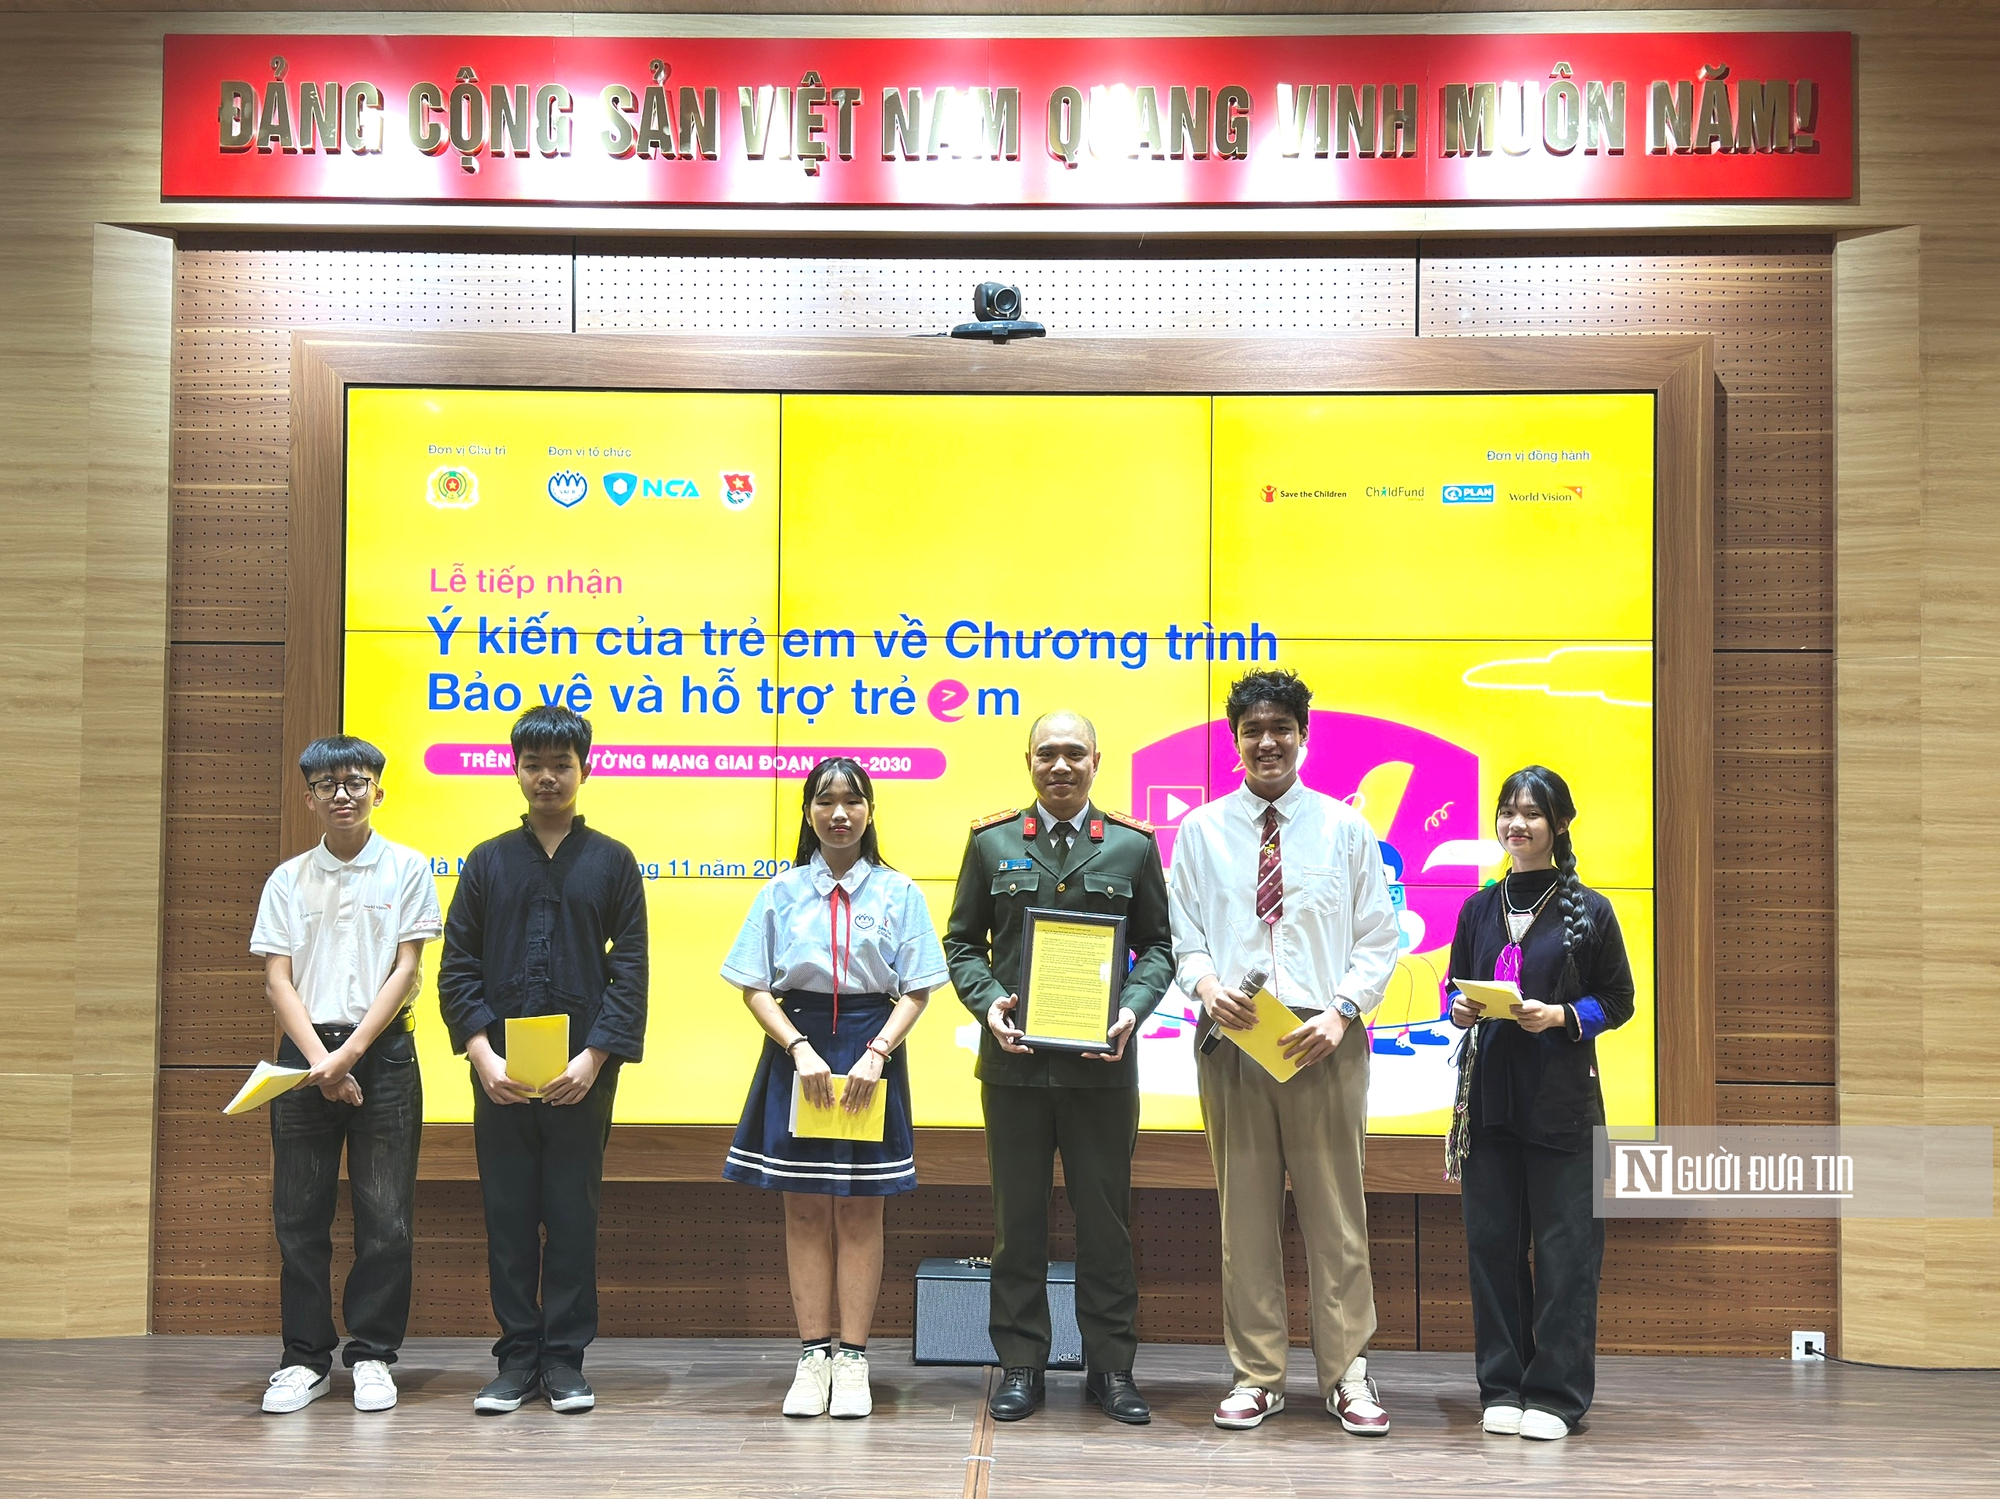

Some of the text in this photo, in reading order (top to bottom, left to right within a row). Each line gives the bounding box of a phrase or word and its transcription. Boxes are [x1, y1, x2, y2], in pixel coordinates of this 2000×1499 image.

[219, 56, 1819, 175] ĐẢNG CỘNG SẢN VIỆT NAM QUANG VINH MUÔN NĂM!
[429, 444, 452, 455] Đơn
[549, 446, 572, 456] Đơn
[1487, 450, 1511, 461] Đơn
[643, 479, 700, 497] NCA
[1280, 490, 1298, 498] Save
[1314, 490, 1347, 498] Children
[1464, 487, 1492, 497] PLAN
[1509, 492, 1572, 501] World Vision
[431, 563, 623, 599] Lễ tiếp nhận
[428, 605, 1277, 669] Ý kiến của trẻ em về Chương trình
[428, 671, 522, 712] Bảo
[609, 674, 663, 714] và
[682, 668, 741, 715] hỗ
[757, 676, 834, 724] trợ
[851, 675, 916, 716] trẻ
[460, 750, 912, 774] TRÊN ƯỜNG MẠNG GIAI ĐOẠN -2030
[668, 859, 689, 876] 11
[699, 859, 746, 876] năm
[753, 859, 791, 877] 202
